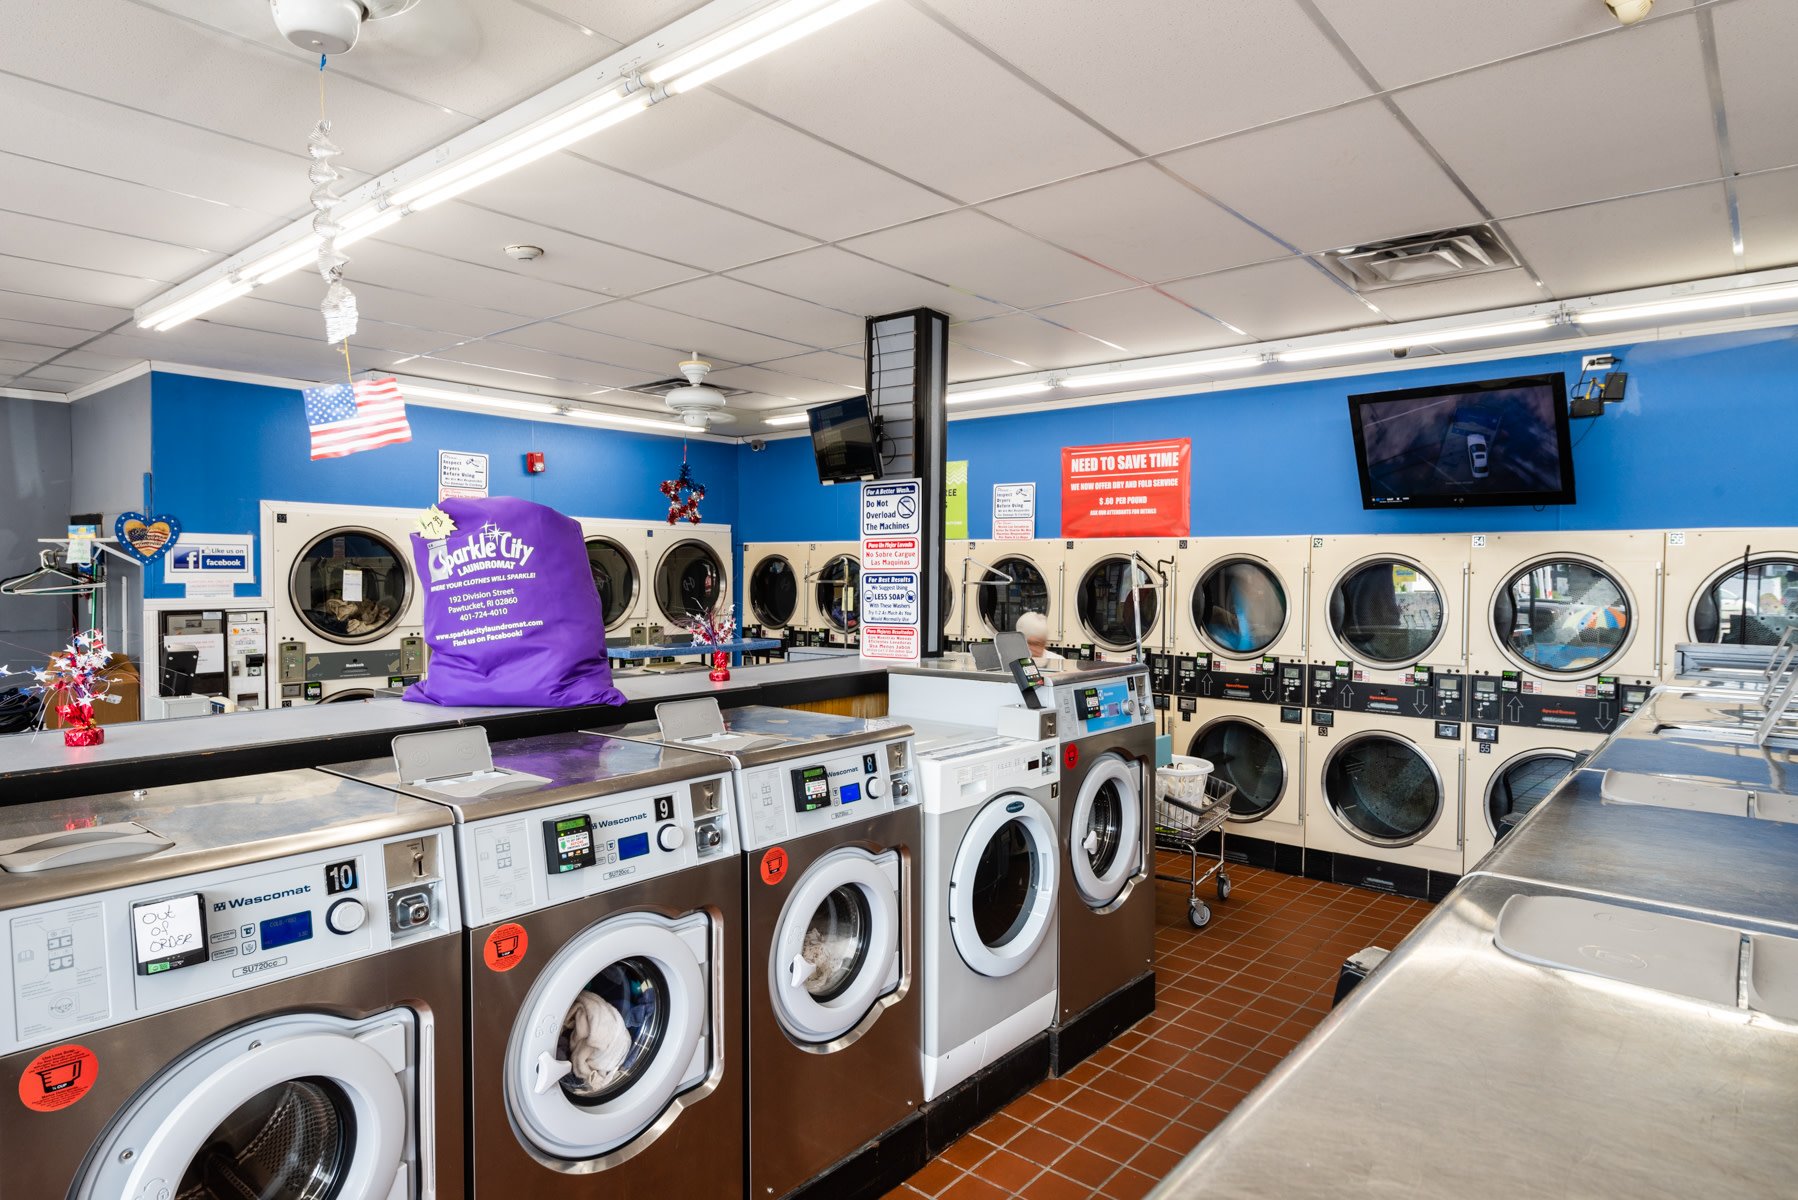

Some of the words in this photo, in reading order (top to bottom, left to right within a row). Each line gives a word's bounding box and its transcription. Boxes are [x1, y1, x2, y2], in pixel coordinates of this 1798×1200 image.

[1071, 458, 1098, 472] NEED
[1100, 456, 1115, 471] TO
[1117, 454, 1147, 469] SAVE
[1149, 452, 1179, 468] TIME
[1071, 483, 1080, 491] WE
[1081, 482, 1095, 490] NOW
[1095, 481, 1112, 490] OFFER
[1125, 480, 1138, 489] AND
[1153, 478, 1178, 487] SERVICE
[866, 500, 875, 508] Do
[877, 499, 888, 508] Not
[1115, 497, 1127, 505] PER
[866, 510, 896, 519] Overload
[866, 523, 877, 531] The
[880, 521, 910, 530] Machines
[1179, 541, 1188, 549] 50
[438, 532, 497, 577] Sparkle
[500, 531, 535, 567] City
[894, 551, 915, 559] Cargue
[206, 558, 241, 566] facebook
[457, 560, 516, 577] LAUNDROMAT
[882, 559, 910, 567] Maquinas
[446, 581, 462, 590] YOUR
[463, 577, 490, 587] CLOTHES
[491, 575, 507, 583] WILL
[506, 572, 536, 581] SPARKLE!
[449, 595, 461, 604] 192
[462, 591, 491, 602] Division
[492, 588, 514, 597] Street
[874, 593, 888, 601] LESS
[889, 593, 905, 601] SOAP
[448, 602, 485, 613] Pawtucket,
[494, 597, 518, 606] 02860
[459, 608, 508, 621] 401-724-4010
[435, 619, 543, 640] www.sparklecitylaundromat.com
[452, 638, 467, 647] Find
[486, 630, 523, 641] Facebook!
[1319, 727, 1328, 736] 53
[1480, 743, 1490, 752] 55
[866, 756, 873, 772] 8
[827, 766, 858, 778] Wascomat
[660, 799, 668, 818] 9
[598, 812, 648, 829] Wascomat
[329, 864, 353, 891] 10
[229, 884, 311, 909] Wascomat
[142, 904, 176, 925] Out
[150, 933, 193, 953] ORDER
[242, 960, 278, 975] SU720cc
